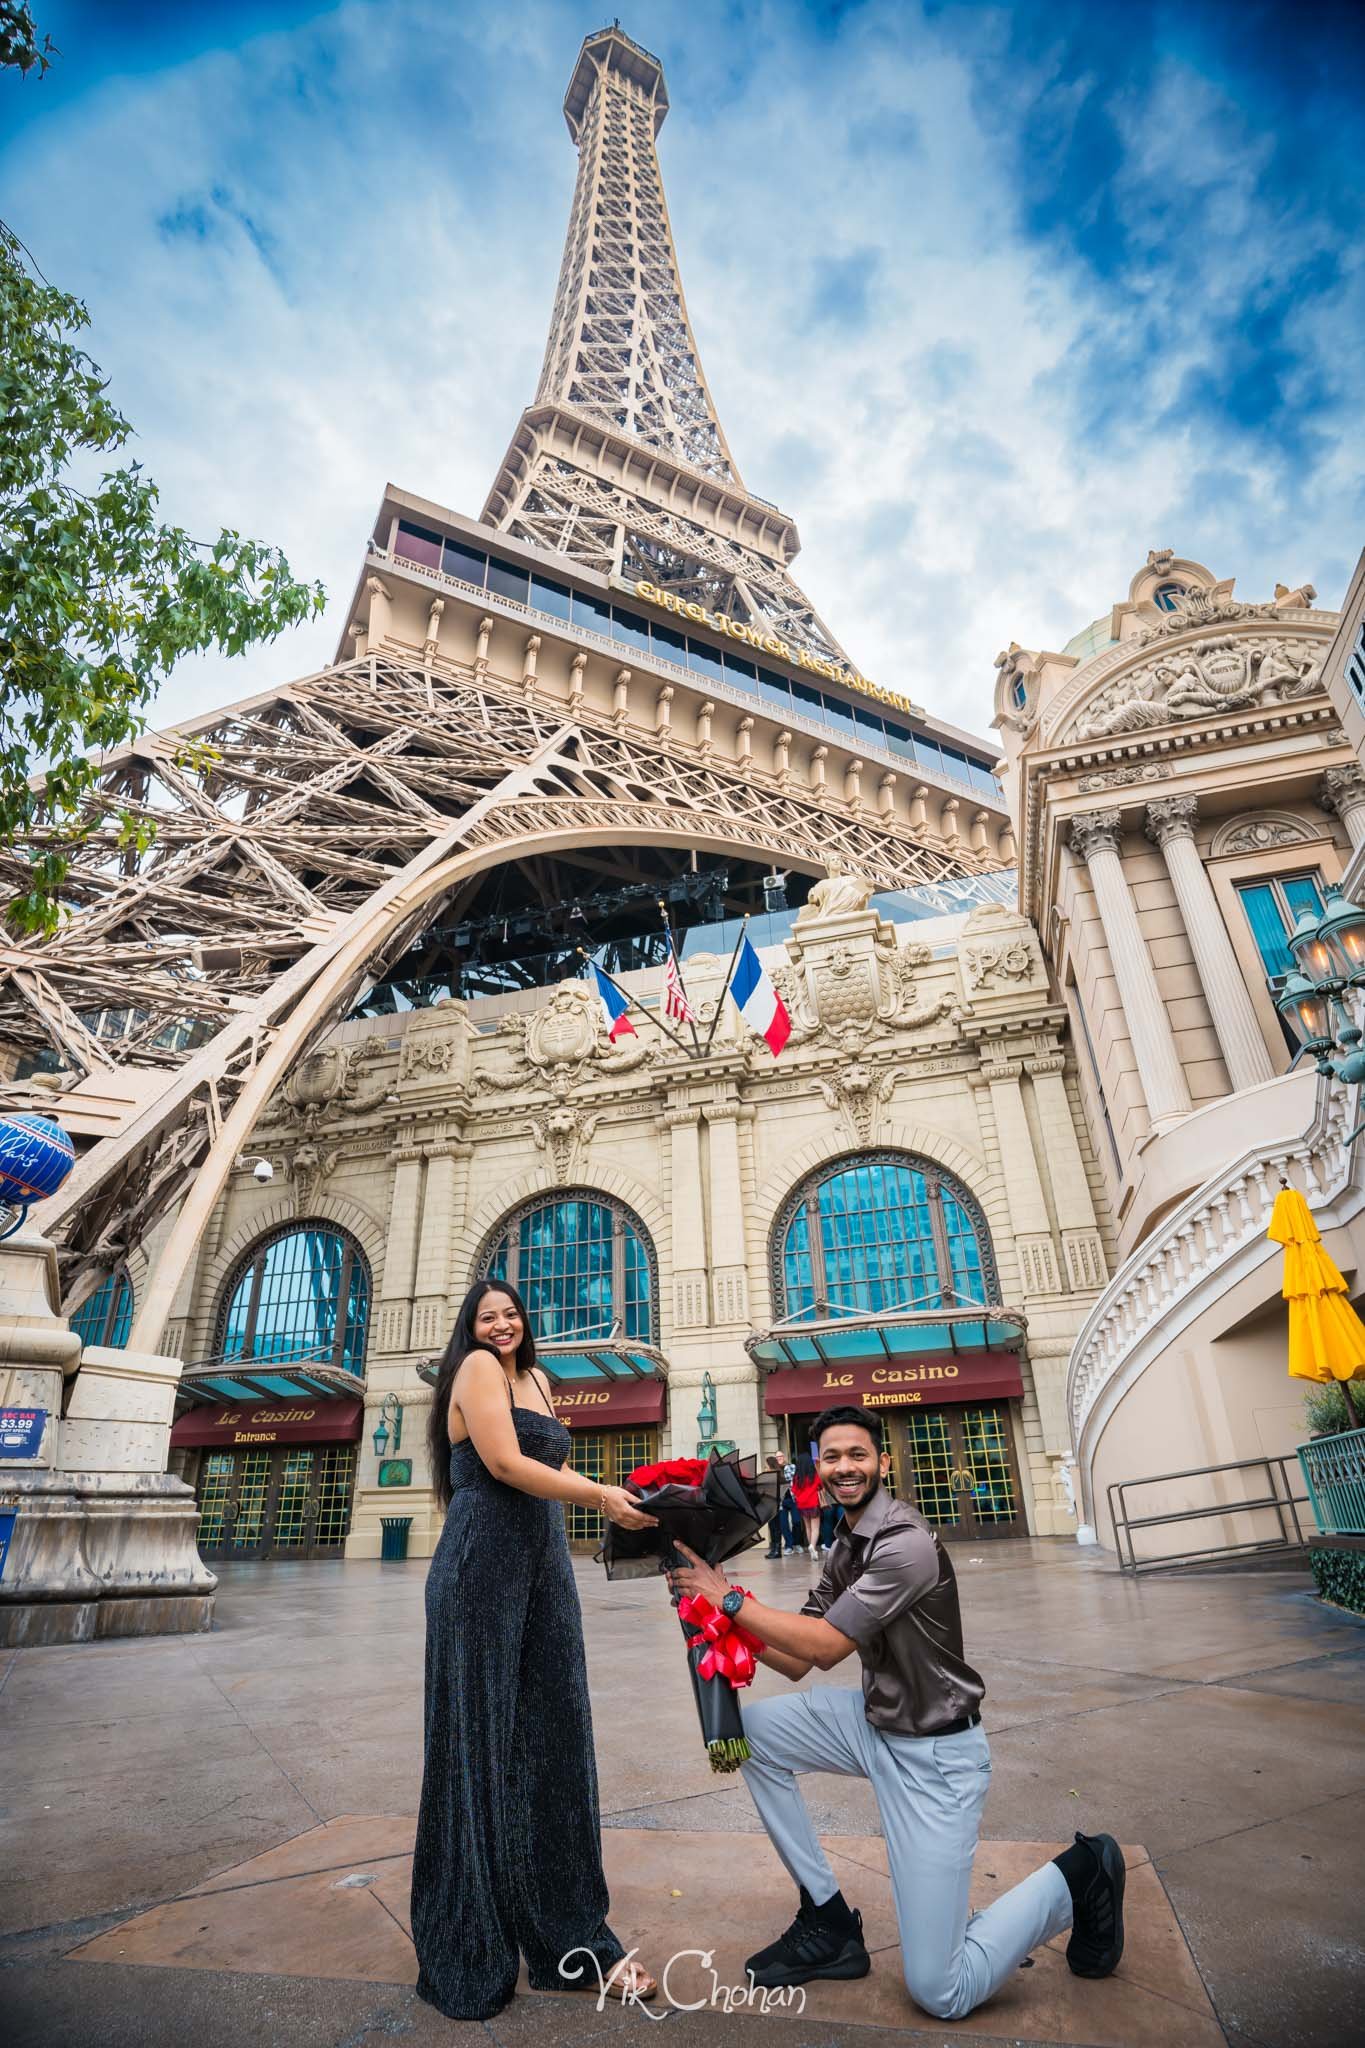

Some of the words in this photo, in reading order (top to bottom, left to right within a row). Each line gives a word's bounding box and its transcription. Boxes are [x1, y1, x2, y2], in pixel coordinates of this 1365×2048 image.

[635, 581, 713, 626] EIFFEL
[714, 611, 793, 662] TOWER
[797, 647, 911, 715] RESTAURANT
[616, 1103, 653, 1116] ANGERS
[822, 1372, 854, 1388] Le
[871, 1364, 959, 1384] Casino
[552, 1391, 610, 1406] asino
[862, 1391, 922, 1406] Entrance
[0, 1419, 33, 1429] $3.99
[214, 1411, 241, 1425] Le
[251, 1408, 316, 1424] Casino
[234, 1431, 277, 1443] Entrance
